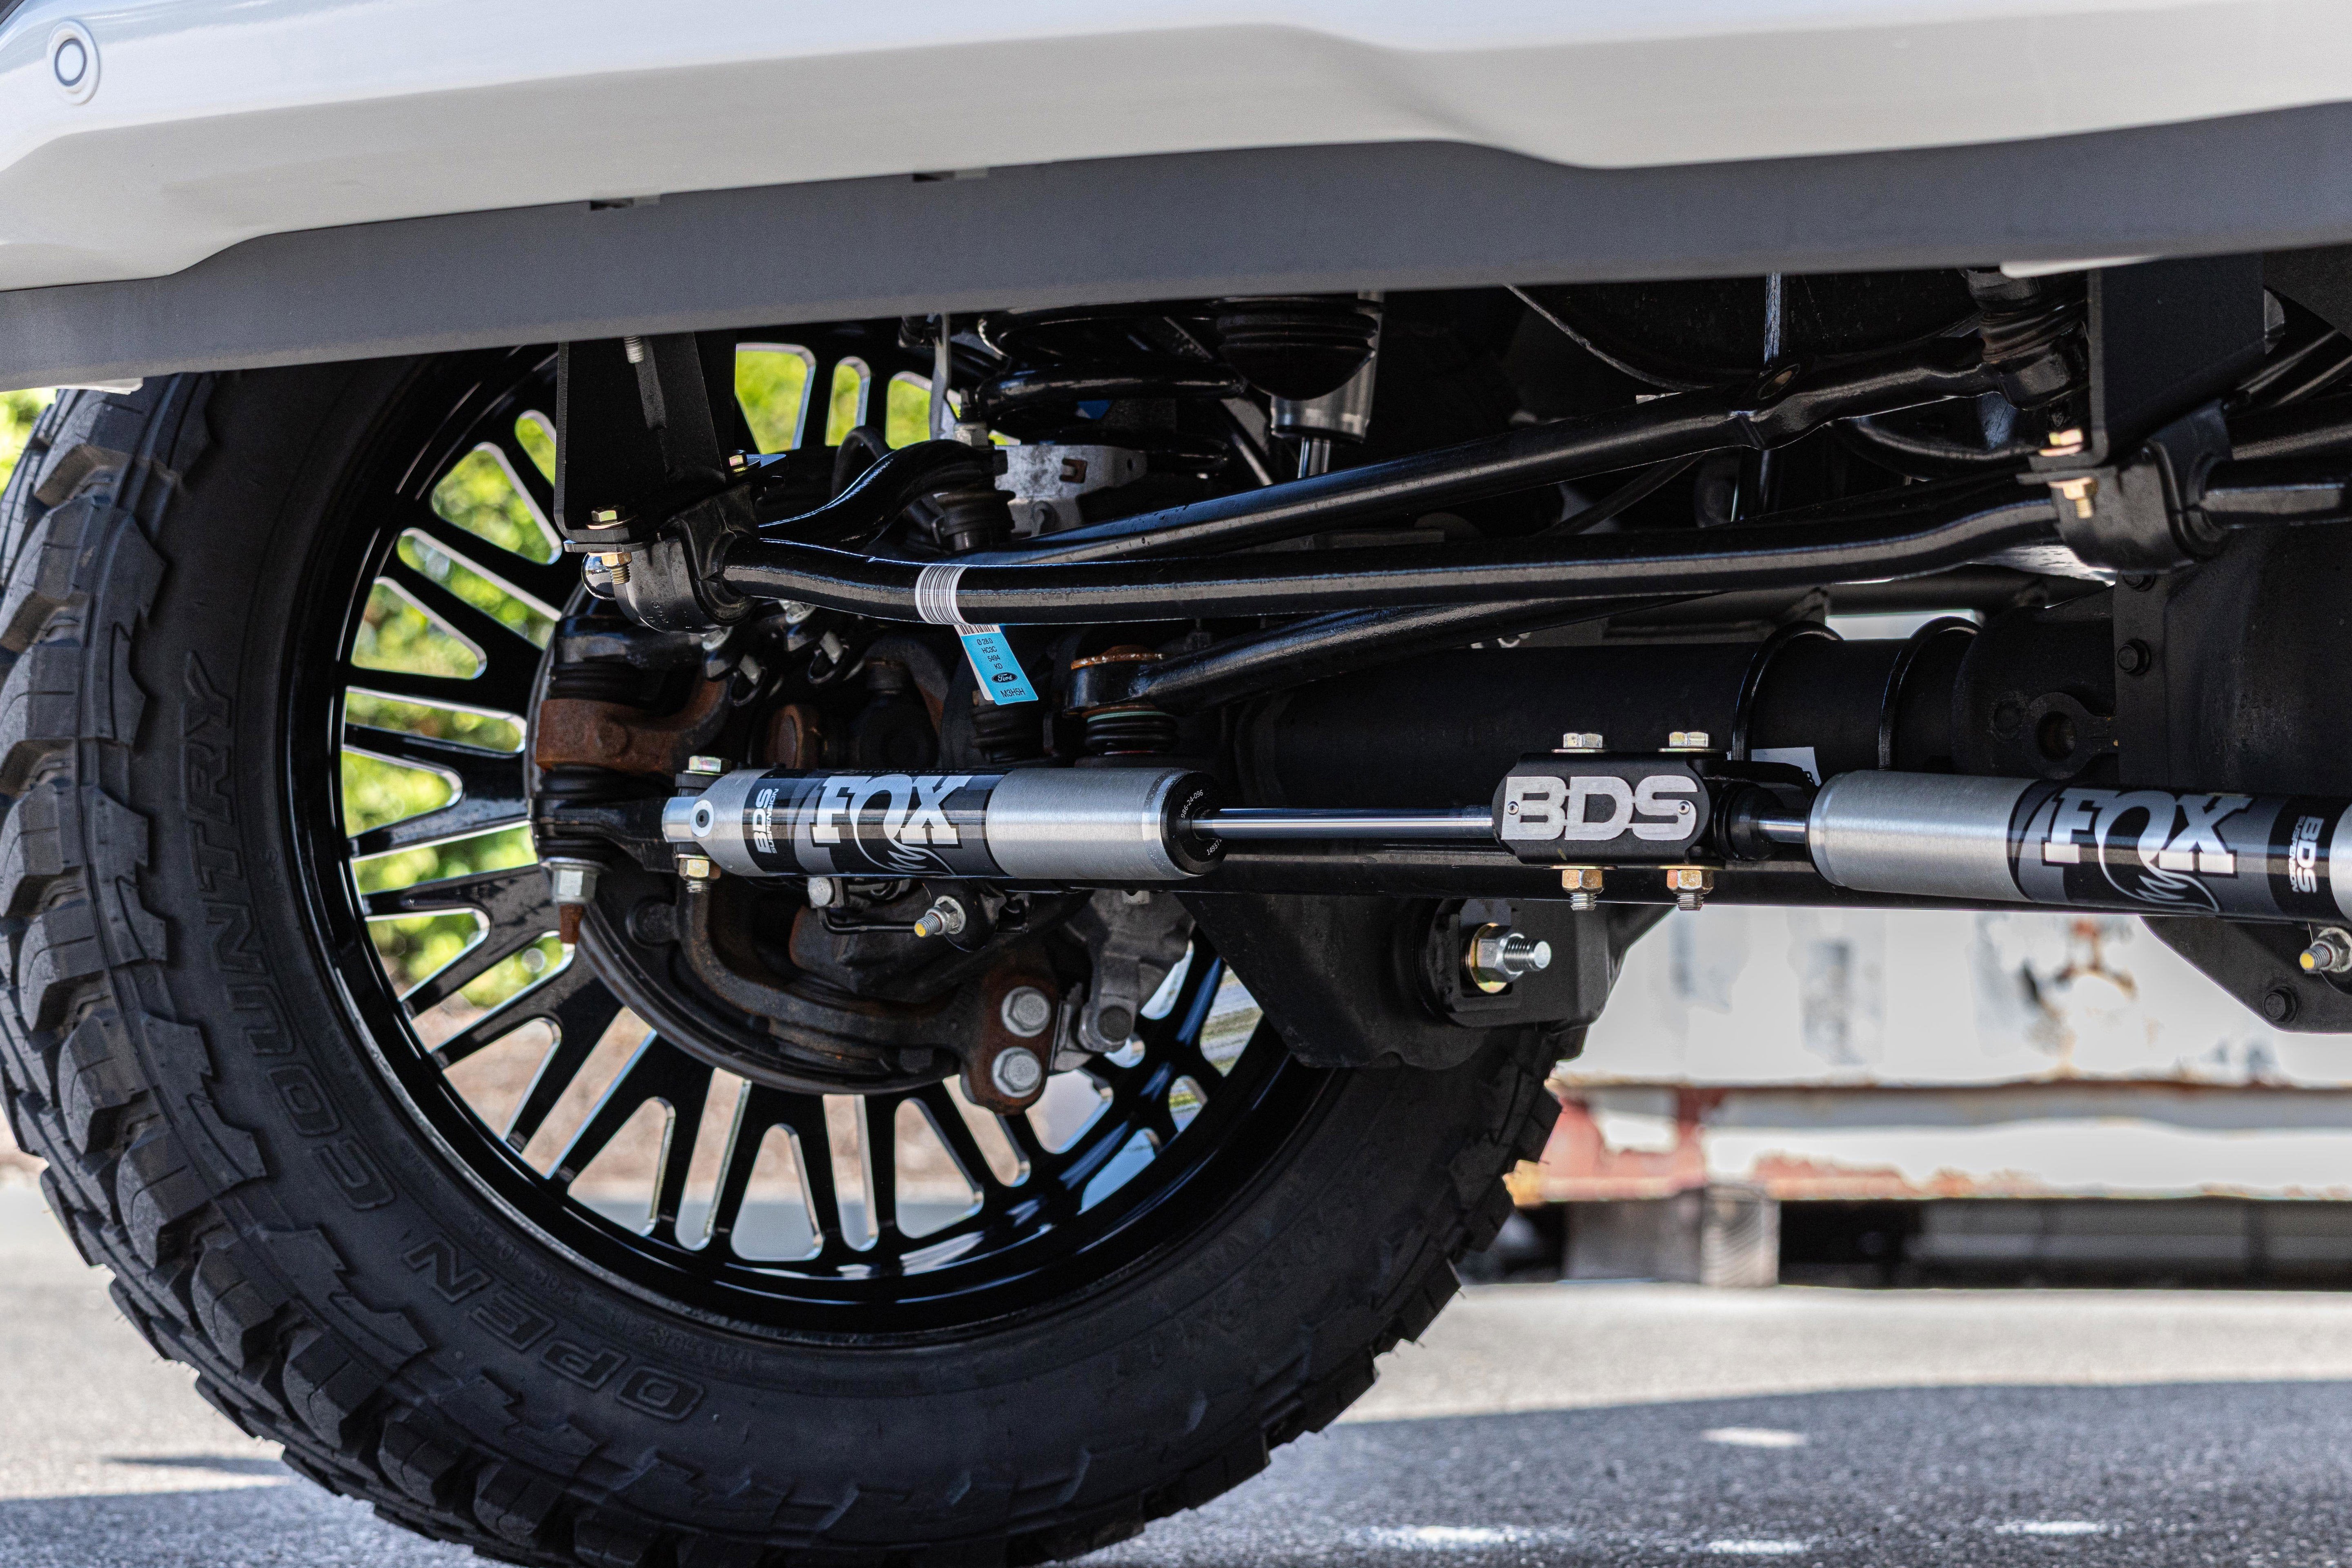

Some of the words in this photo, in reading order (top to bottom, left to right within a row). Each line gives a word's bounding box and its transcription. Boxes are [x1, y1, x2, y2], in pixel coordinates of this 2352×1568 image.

[998, 673, 1013, 682] Ford
[1000, 688, 1026, 698] M3H5H
[752, 788, 773, 853] BDS
[766, 788, 779, 853] SUSPENSION
[812, 774, 973, 875] FOX
[1180, 789, 1203, 819] 986-24-096
[1501, 775, 1698, 840] BDS
[2045, 787, 2254, 912] FOX
[2296, 816, 2324, 893] BDS
[182, 650, 397, 1212] COUNTRY
[401, 1231, 706, 1422] OPEN
